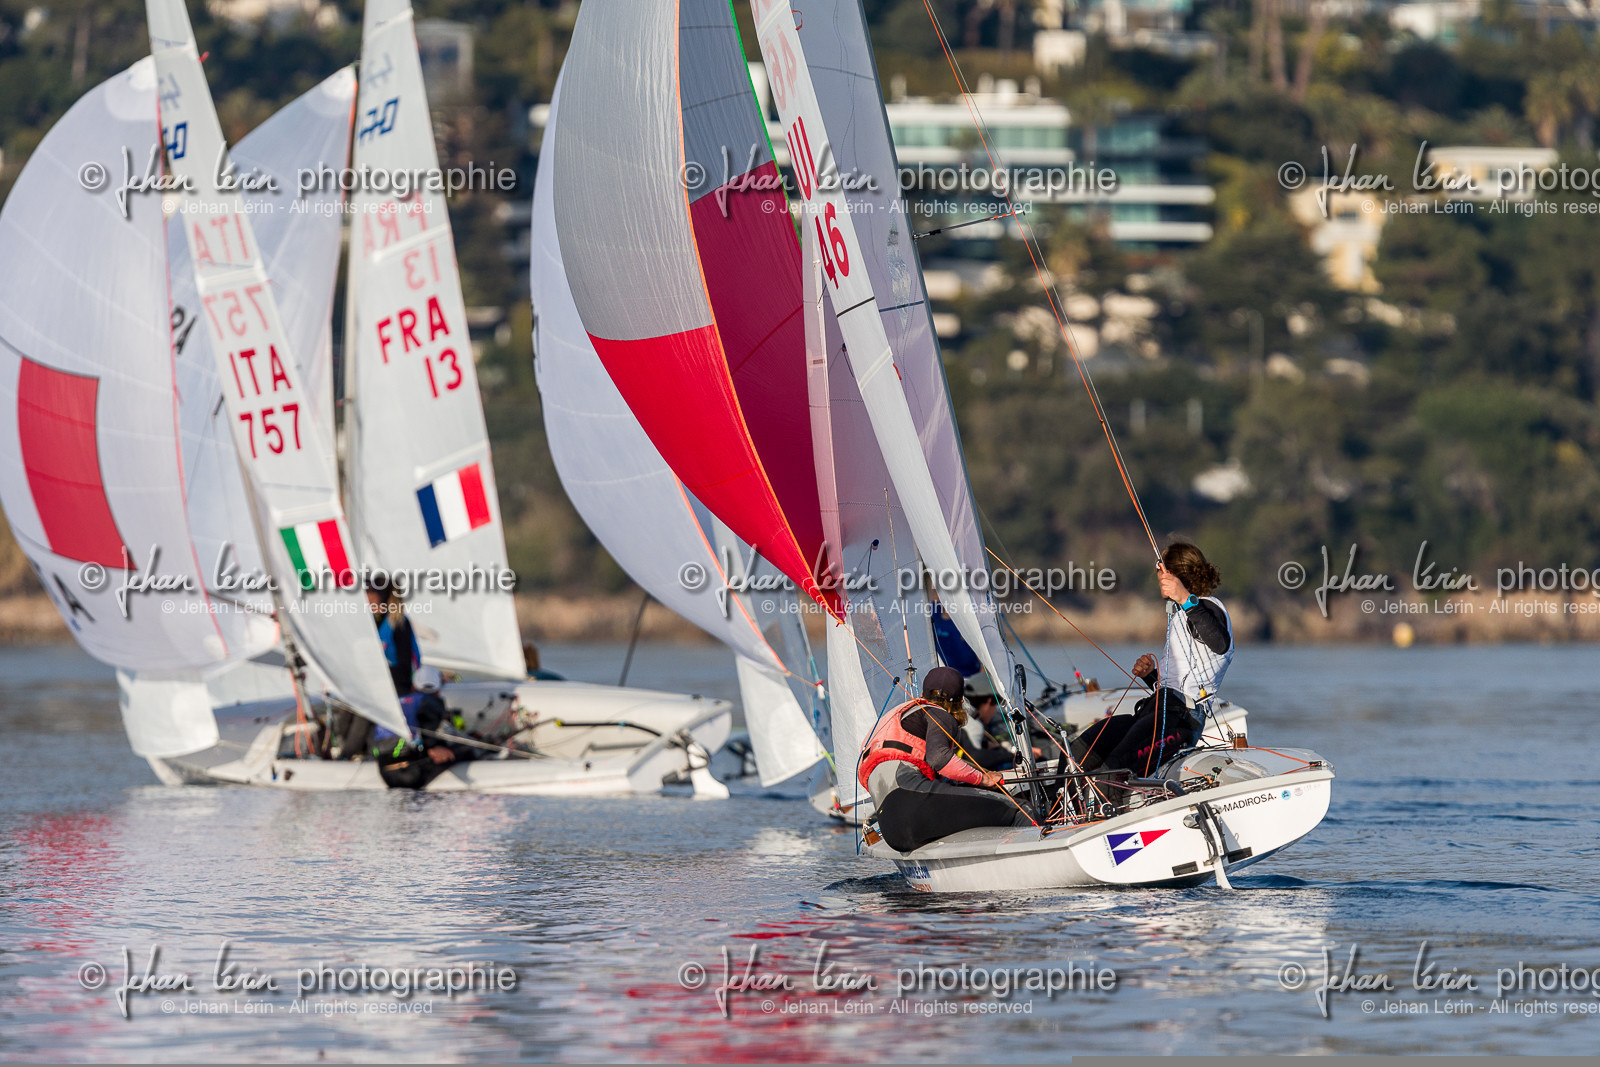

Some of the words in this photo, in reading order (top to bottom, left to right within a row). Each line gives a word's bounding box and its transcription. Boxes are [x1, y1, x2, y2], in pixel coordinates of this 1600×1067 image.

[376, 295, 451, 364] FRA
[229, 343, 292, 399] ITA
[424, 348, 464, 399] 13
[239, 402, 302, 459] 757
